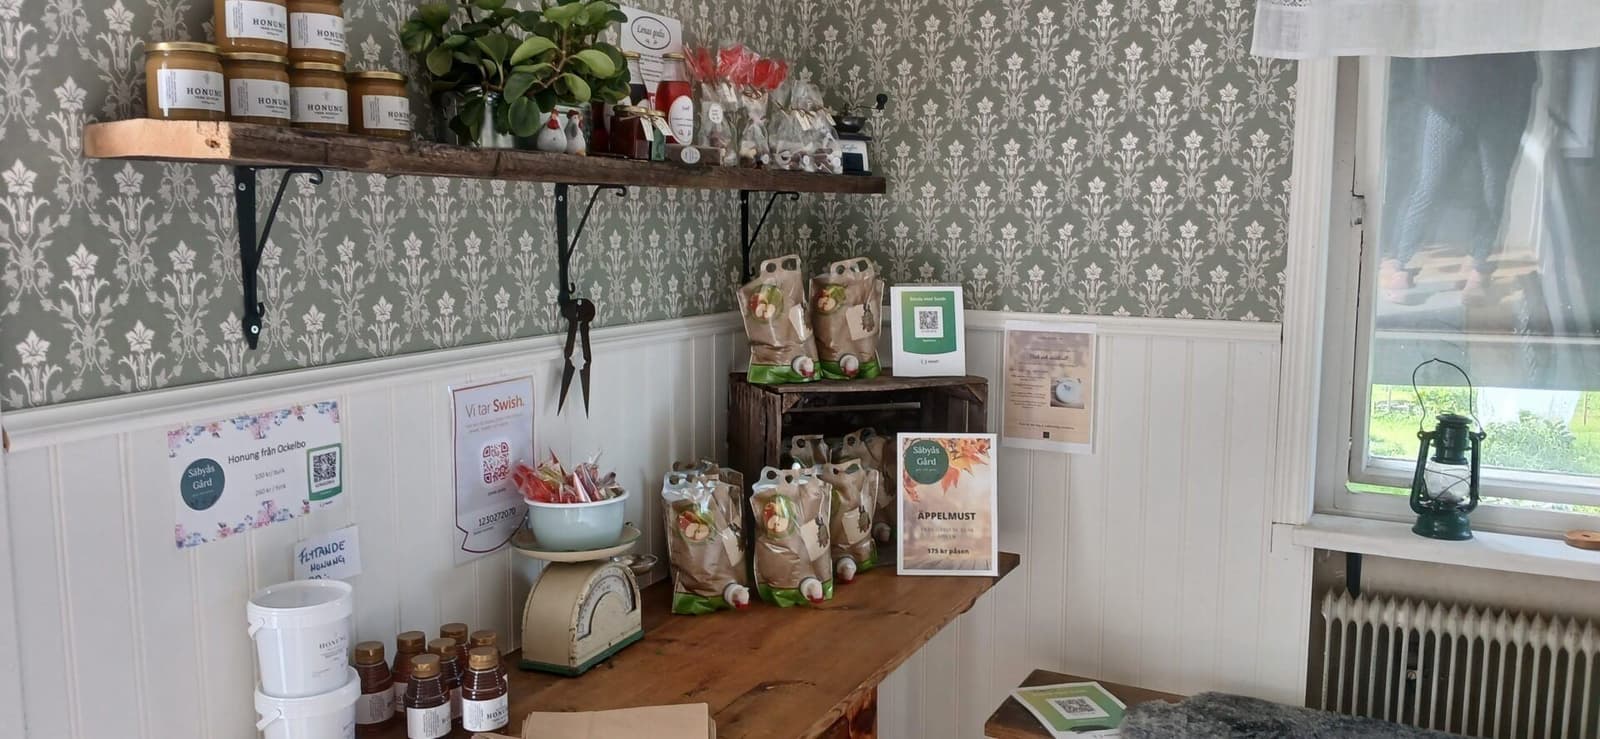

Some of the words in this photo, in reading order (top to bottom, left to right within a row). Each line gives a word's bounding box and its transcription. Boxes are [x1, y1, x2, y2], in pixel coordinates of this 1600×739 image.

[257, 97, 288, 106] HONUN
[465, 403, 476, 418] Vi
[478, 404, 490, 416] tar
[228, 451, 260, 465] Honung
[260, 446, 277, 457] från
[277, 440, 306, 454] Ockelbo
[916, 457, 937, 467] Gård
[192, 477, 213, 490] Gård
[917, 509, 977, 521] ÄPPELMUST
[299, 540, 346, 565] FLYTANDE
[310, 554, 346, 572] HONUNG
